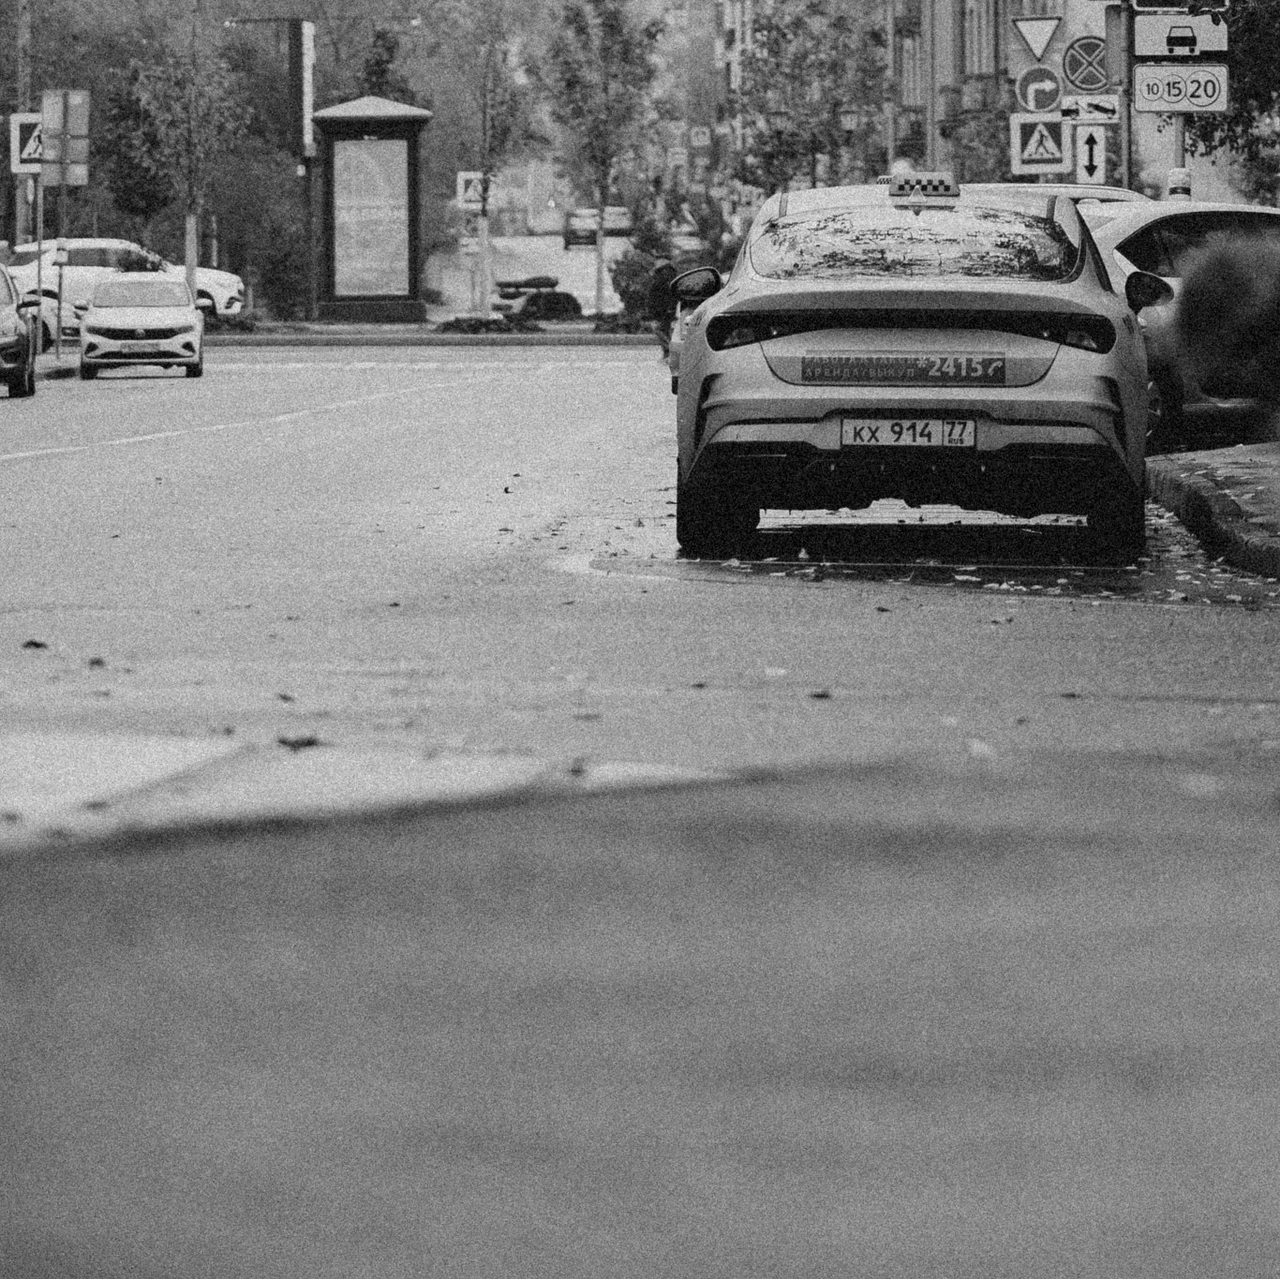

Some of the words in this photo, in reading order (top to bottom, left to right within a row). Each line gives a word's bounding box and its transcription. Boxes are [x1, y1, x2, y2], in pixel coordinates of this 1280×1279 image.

[1146, 82, 1160, 95] 10
[1166, 81, 1182, 97] 15
[1189, 79, 1216, 98] 20
[890, 422, 932, 443] 914
[946, 422, 967, 438] 77
